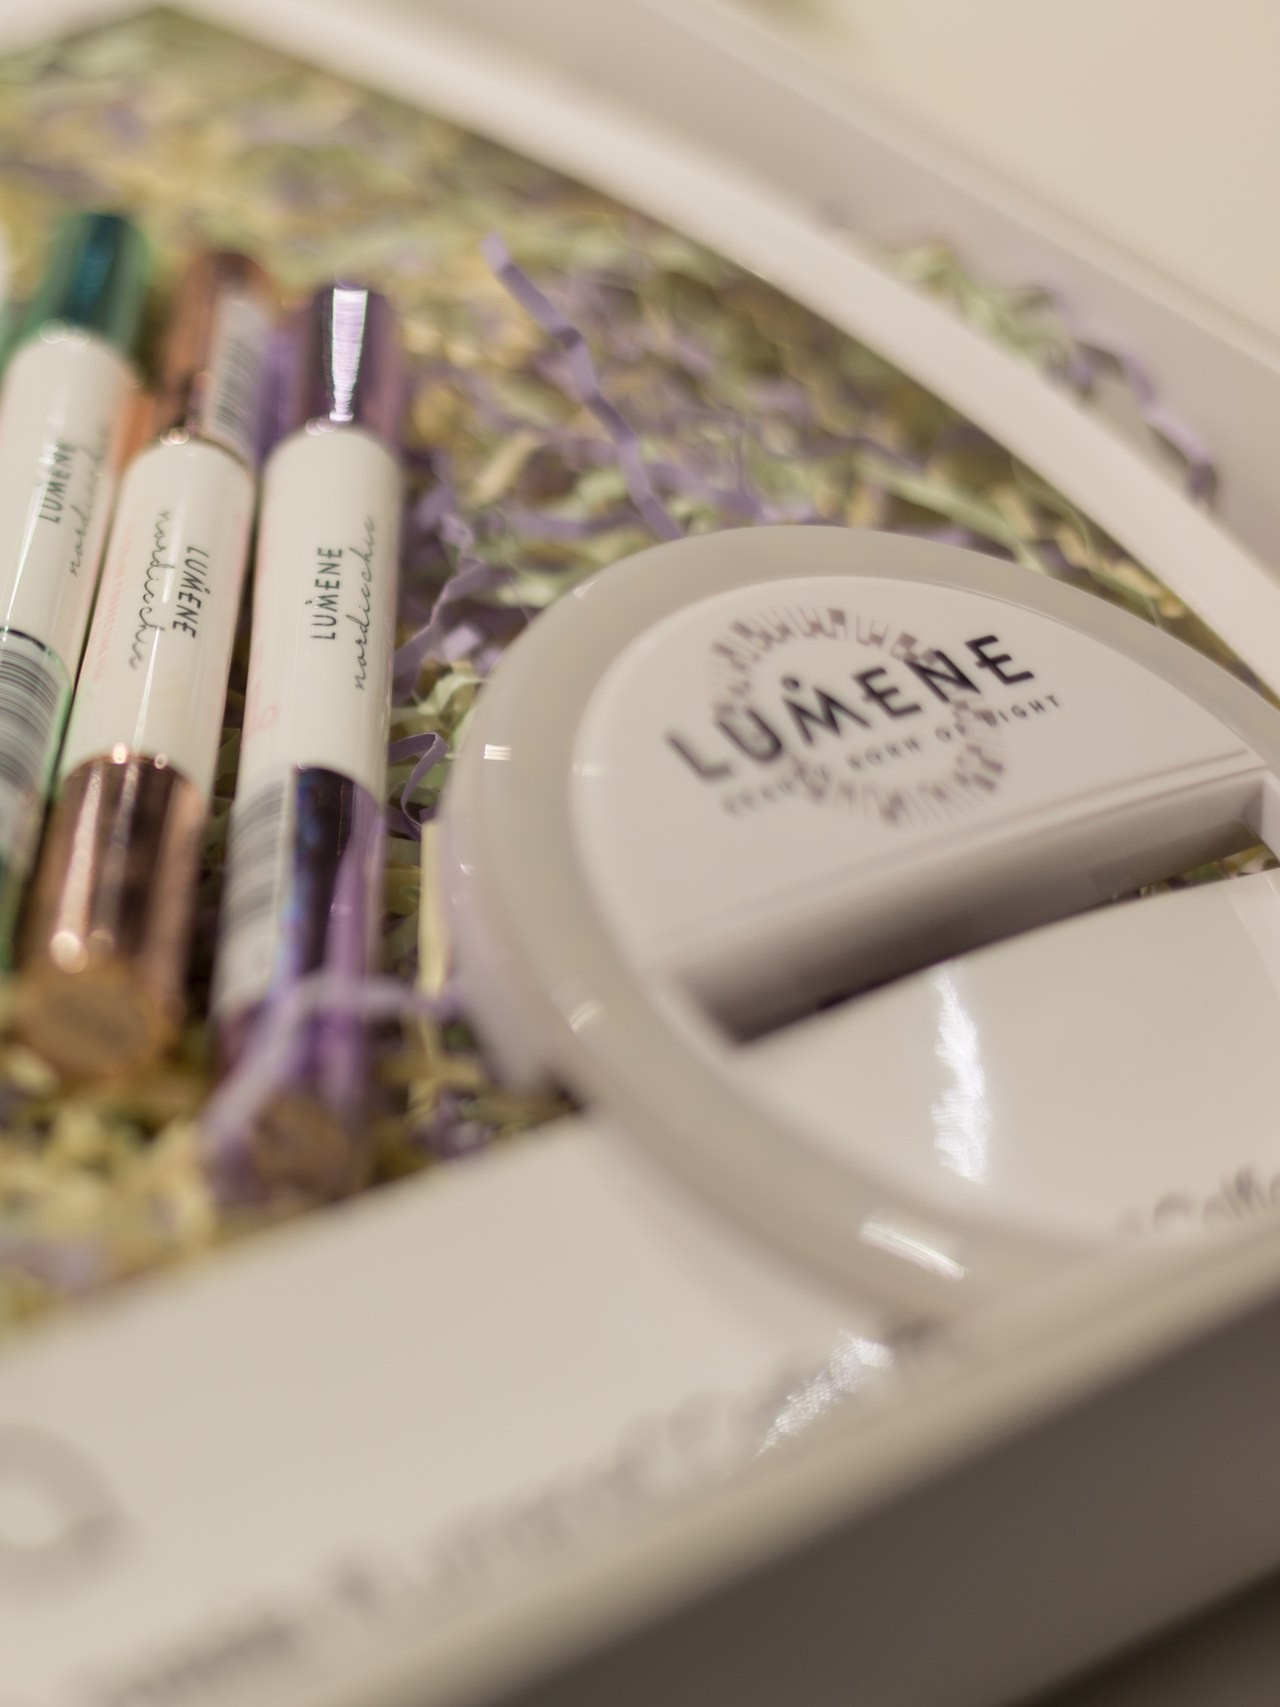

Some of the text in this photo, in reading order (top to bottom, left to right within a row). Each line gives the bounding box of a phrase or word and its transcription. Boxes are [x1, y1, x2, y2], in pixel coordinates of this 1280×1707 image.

[173, 545, 212, 639] LUMENE
[305, 546, 343, 641] LUMENE
[662, 633, 1036, 784] LUMENE
